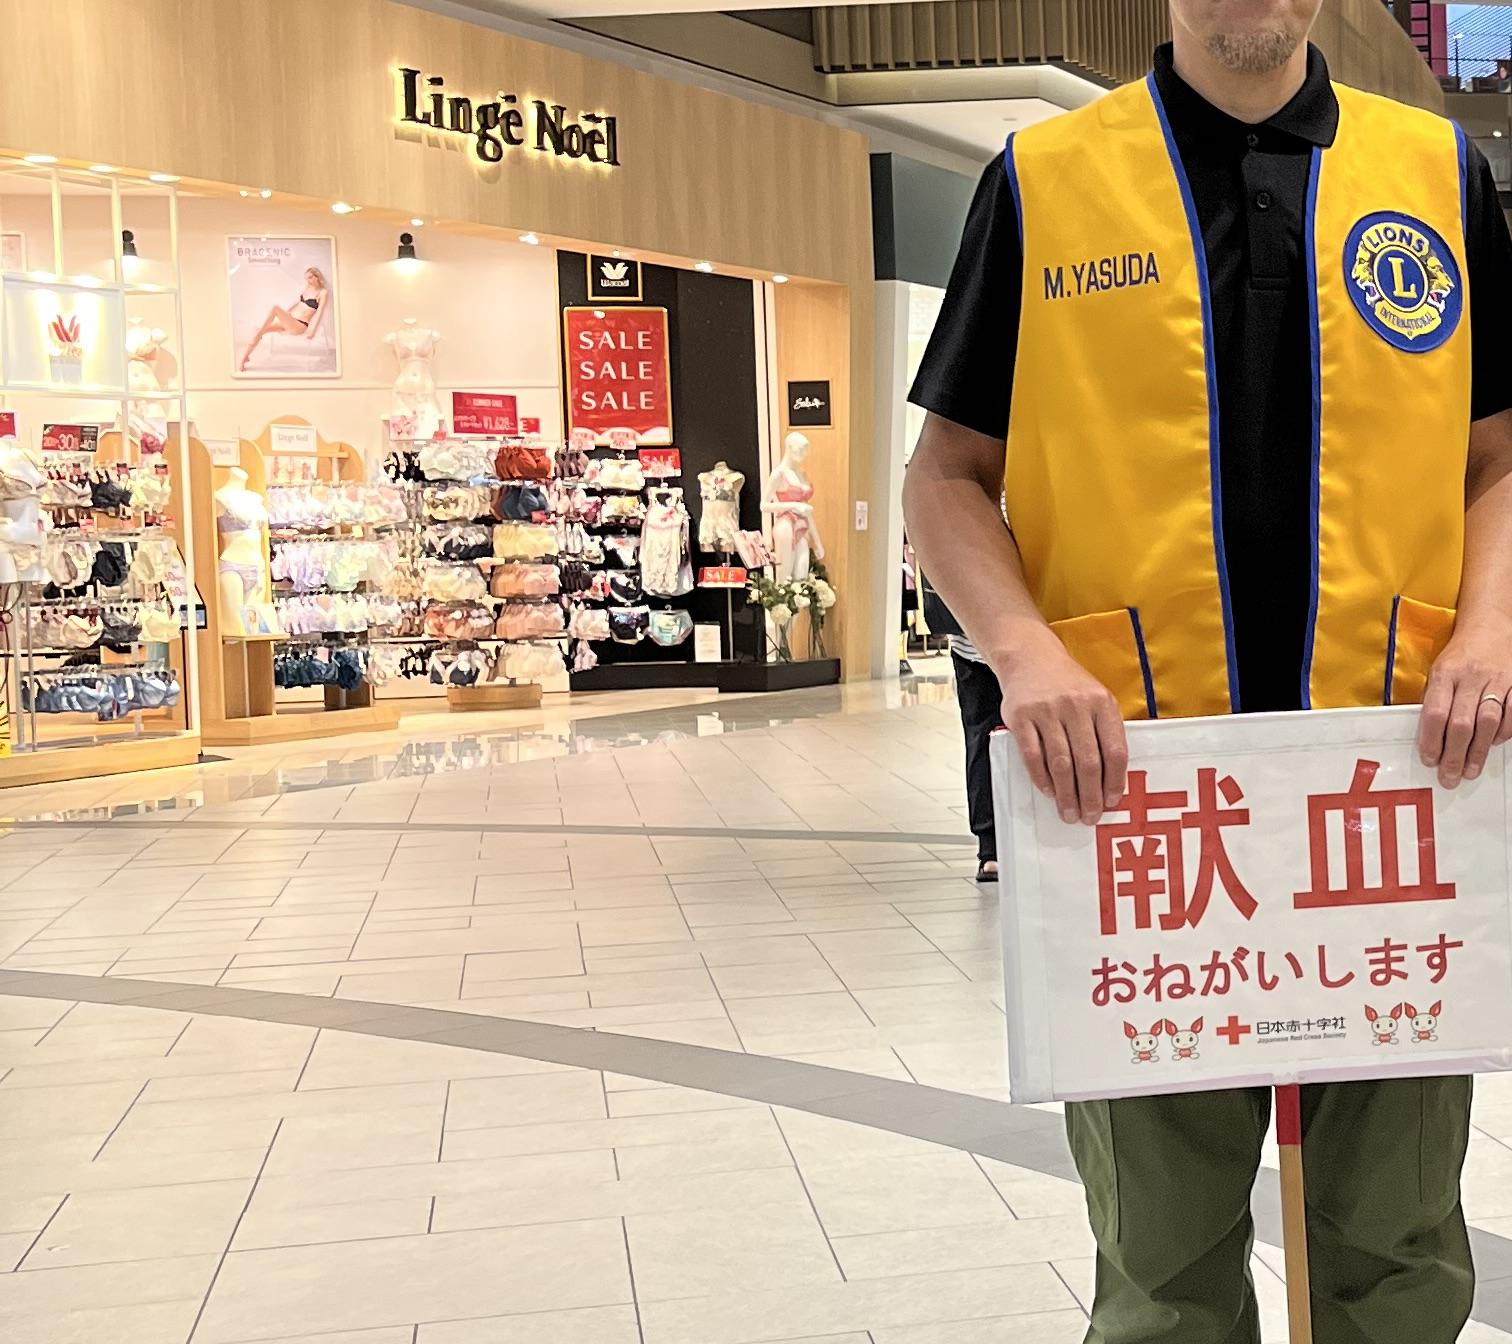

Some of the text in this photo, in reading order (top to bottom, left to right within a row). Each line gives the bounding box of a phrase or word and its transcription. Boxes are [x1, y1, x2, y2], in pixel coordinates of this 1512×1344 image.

[532, 100, 620, 166] Noël
[1366, 227, 1425, 253] LIONS
[1043, 252, 1160, 300] M.YASUDA
[1388, 257, 1418, 299] L
[1380, 306, 1437, 330] INTERNATIONAL
[579, 331, 652, 350] SALE
[580, 361, 654, 380] SALE
[581, 391, 656, 410] SALE
[705, 570, 735, 581] SALE
[1095, 758, 1457, 936] 献血
[1091, 932, 1464, 1007] おねがいします
[1256, 1016, 1347, 1035] 日本赤十字社
